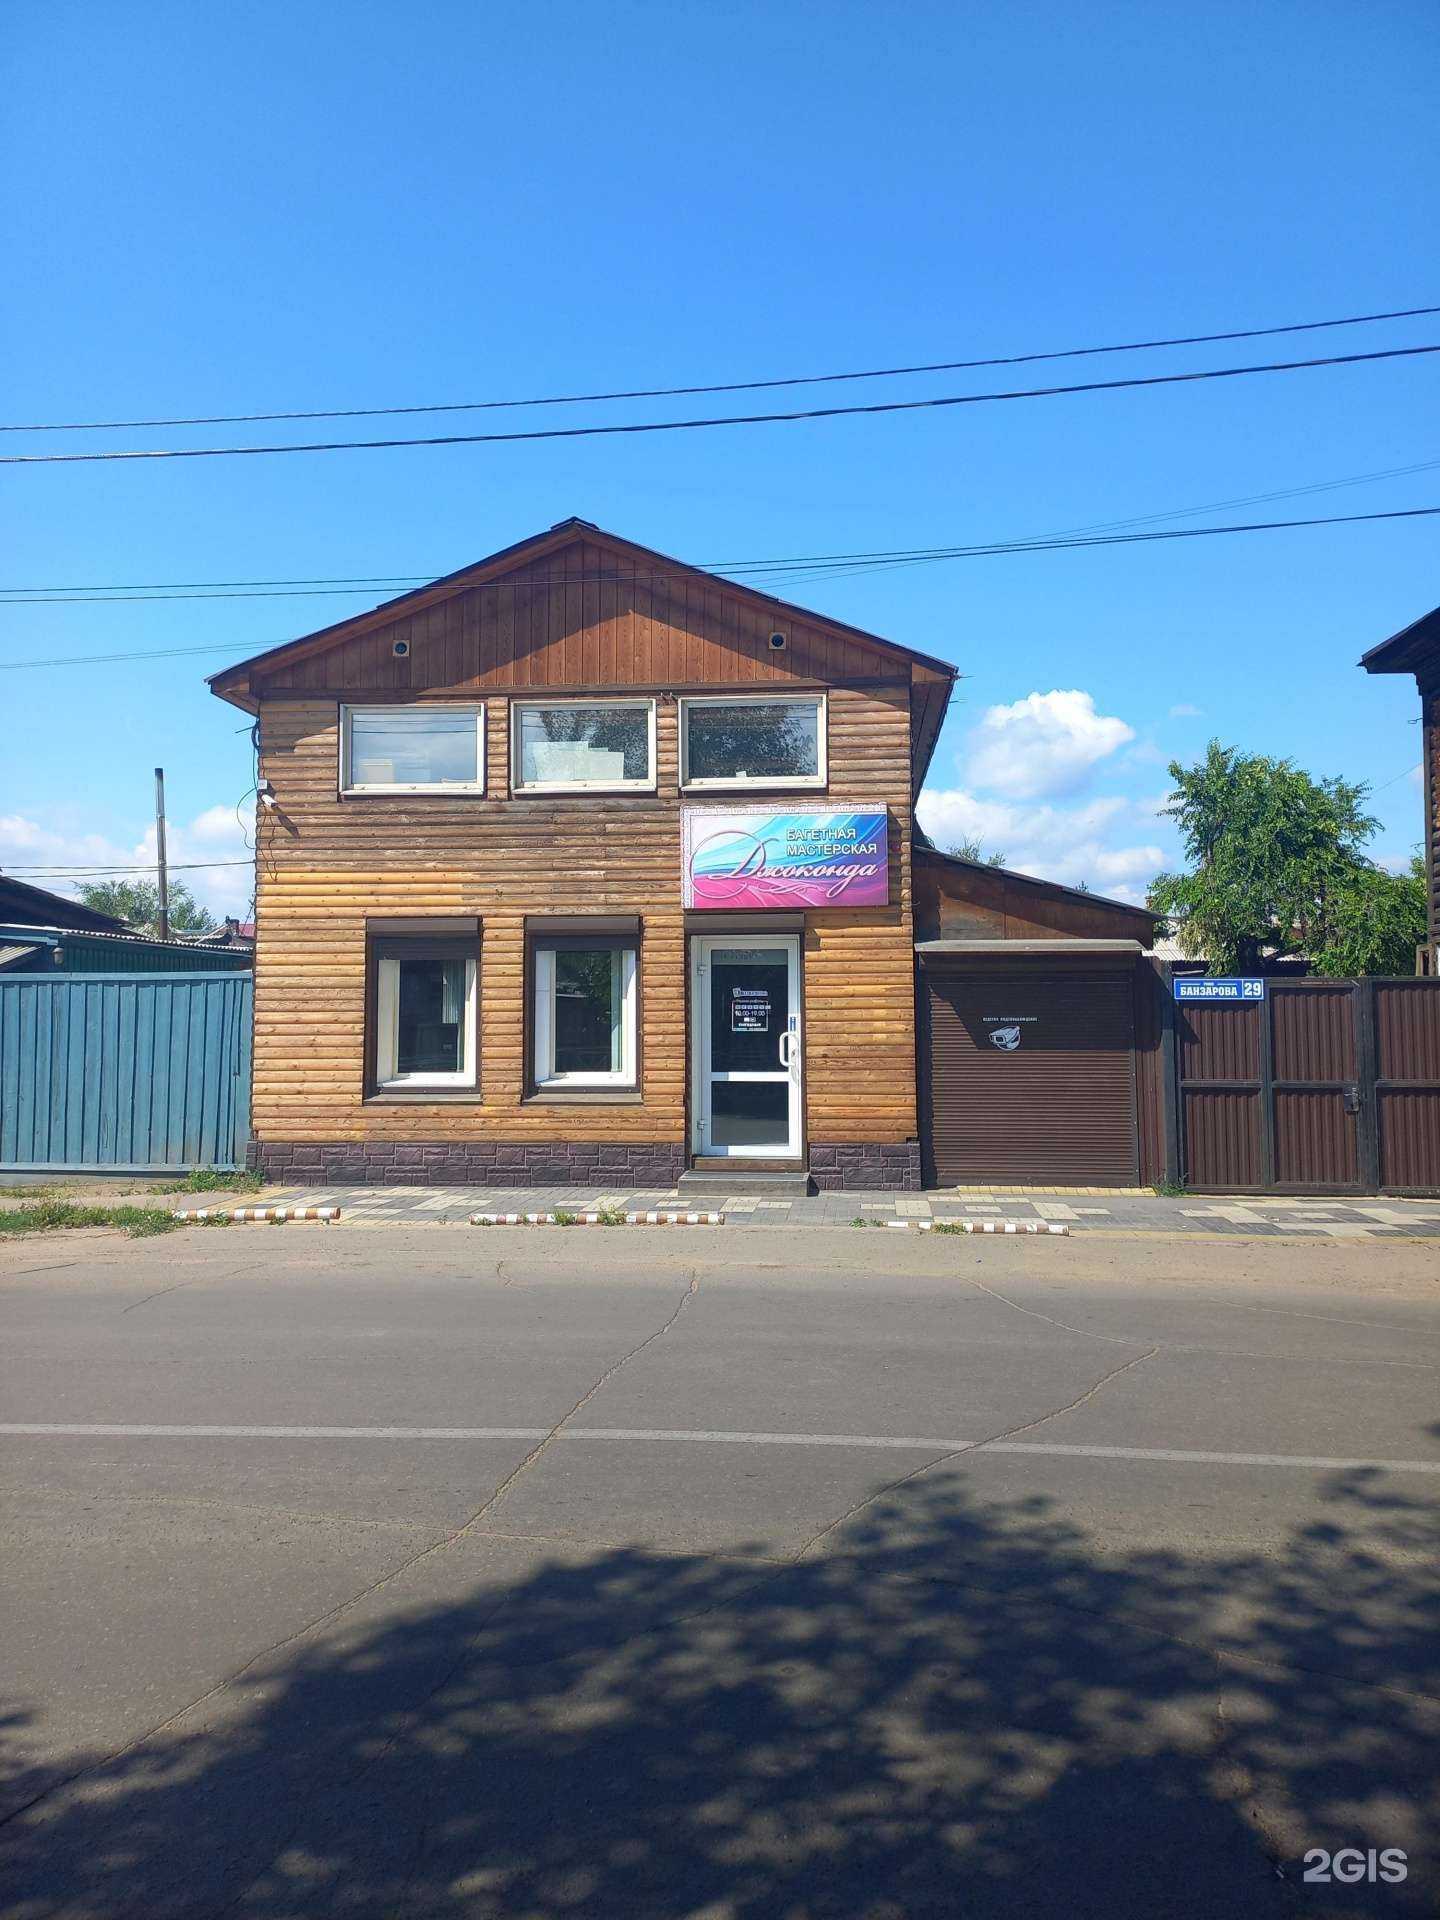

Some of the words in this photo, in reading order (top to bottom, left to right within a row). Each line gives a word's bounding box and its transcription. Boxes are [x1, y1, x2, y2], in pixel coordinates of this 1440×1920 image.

[787, 829, 856, 841] БАГЕТНАЯ
[787, 844, 877, 856] МАСТЕРСКАЯ
[690, 831, 878, 898] Джоконда
[1180, 986, 1238, 996] БАНЗАРОВА
[1244, 982, 1261, 996] 29
